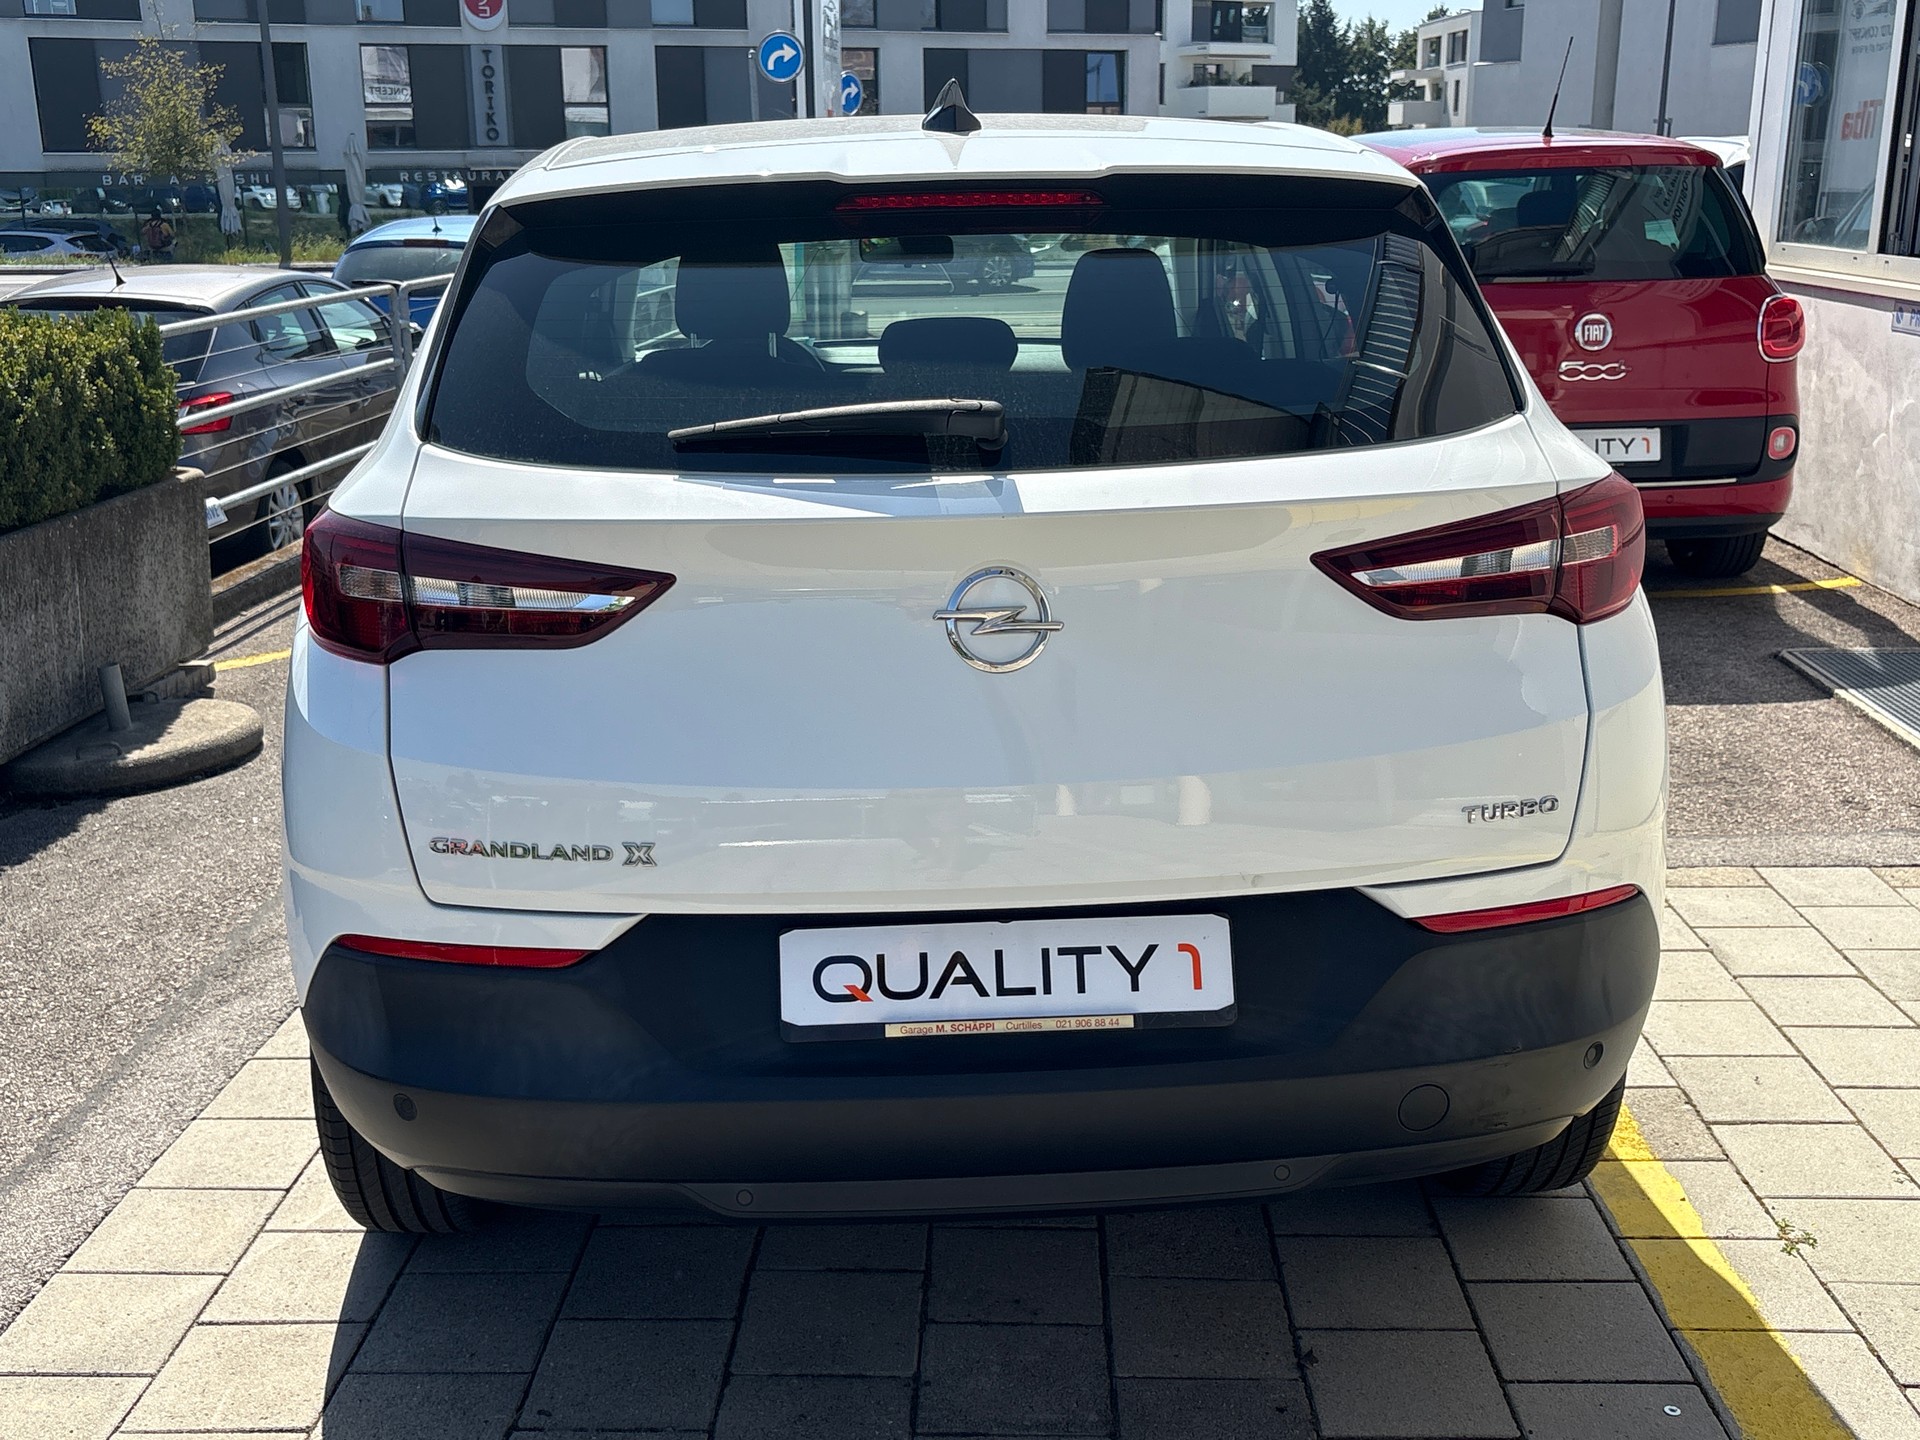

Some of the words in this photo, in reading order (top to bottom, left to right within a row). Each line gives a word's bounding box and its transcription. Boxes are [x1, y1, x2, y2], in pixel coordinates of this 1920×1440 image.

[481, 49, 500, 141] TORIKO
[102, 174, 144, 186] BAR
[1584, 324, 1605, 342] FIAT
[1581, 437, 1636, 455] ITY
[1641, 436, 1651, 454] 1
[1461, 795, 1560, 824] TURBO
[428, 836, 616, 862] GRANDLAND
[621, 841, 658, 867] X
[812, 943, 1160, 1004] QUALITY
[1177, 942, 1203, 991] 1
[899, 1025, 934, 1036] Garage
[936, 1023, 948, 1034] M.
[950, 1020, 995, 1033] SCHÄPPI
[1005, 1021, 1043, 1032] Curtilles
[1055, 1019, 1072, 1029] 021
[1075, 1018, 1092, 1028] 906
[1094, 1018, 1106, 1028] 88
[1108, 1017, 1120, 1027] 44
